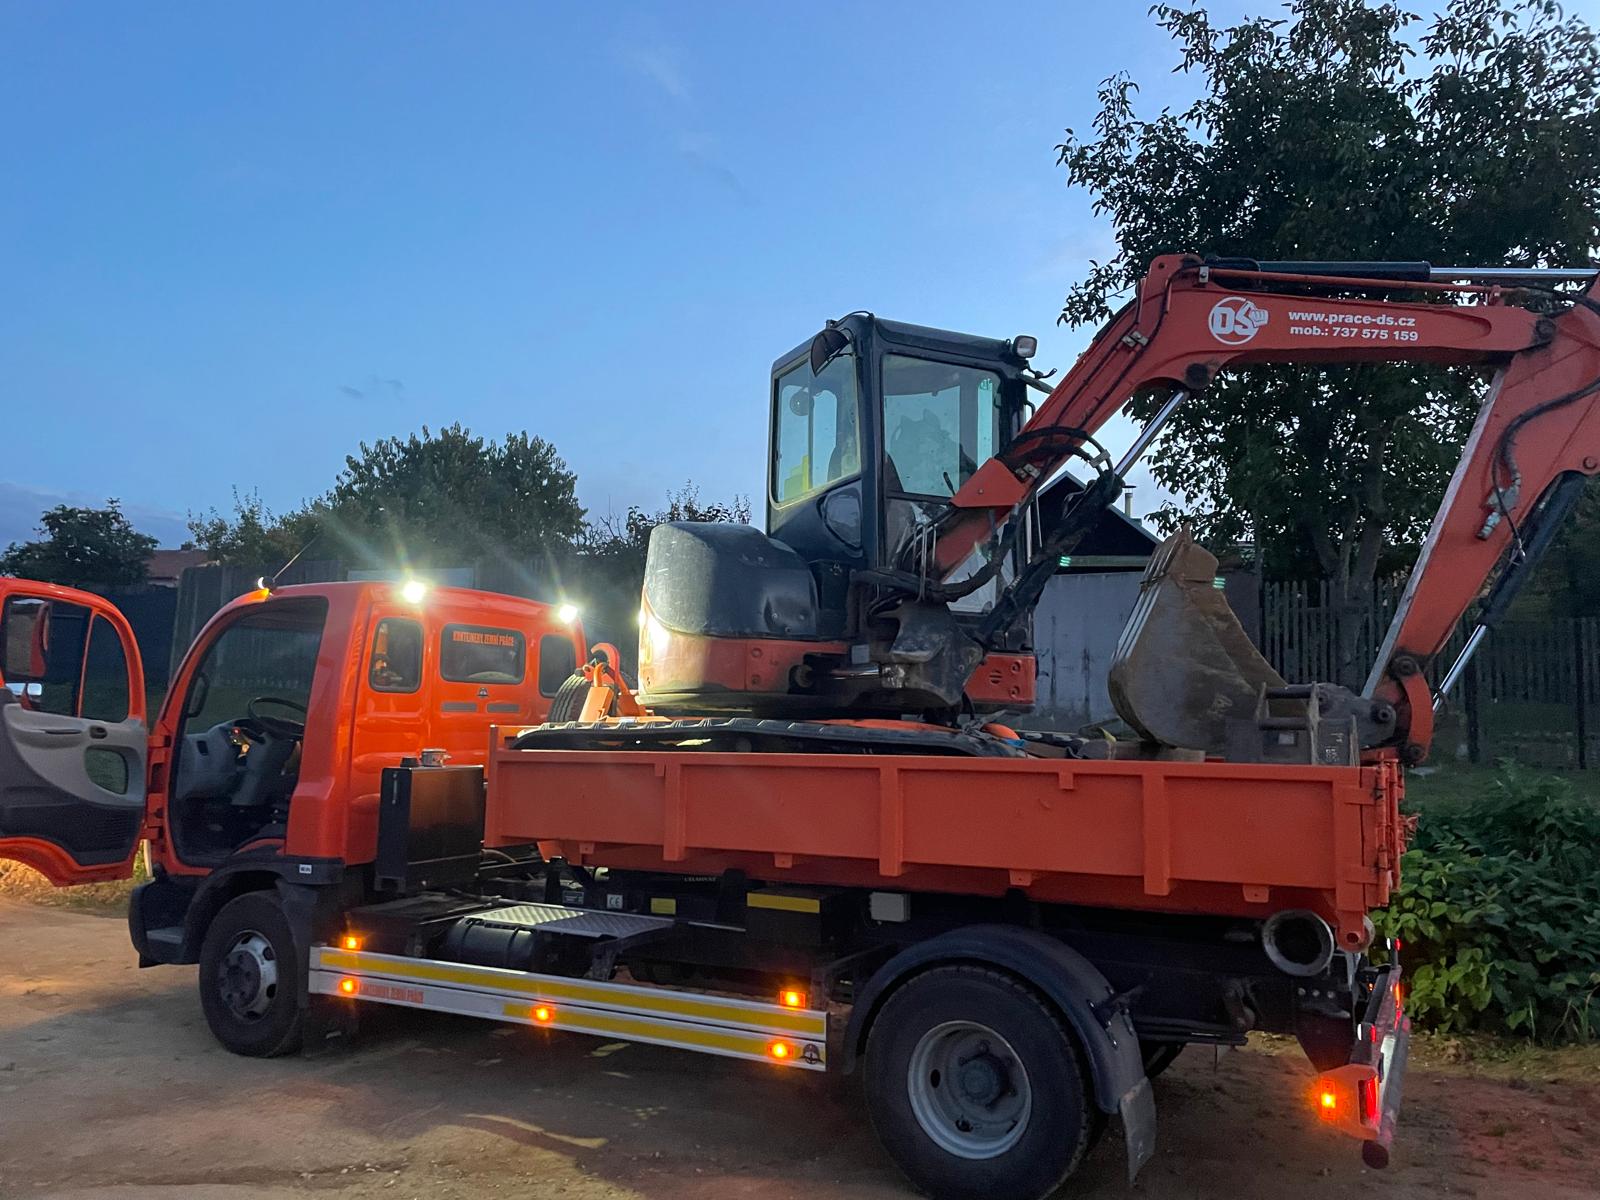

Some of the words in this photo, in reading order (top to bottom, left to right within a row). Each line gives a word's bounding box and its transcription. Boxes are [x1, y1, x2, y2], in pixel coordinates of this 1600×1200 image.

[1288, 310, 1416, 327] www.prace-ds.cz
[1290, 325, 1329, 337] mob.:
[1332, 327, 1358, 339] 737
[1361, 328, 1389, 340] 575
[1392, 330, 1419, 342] 159
